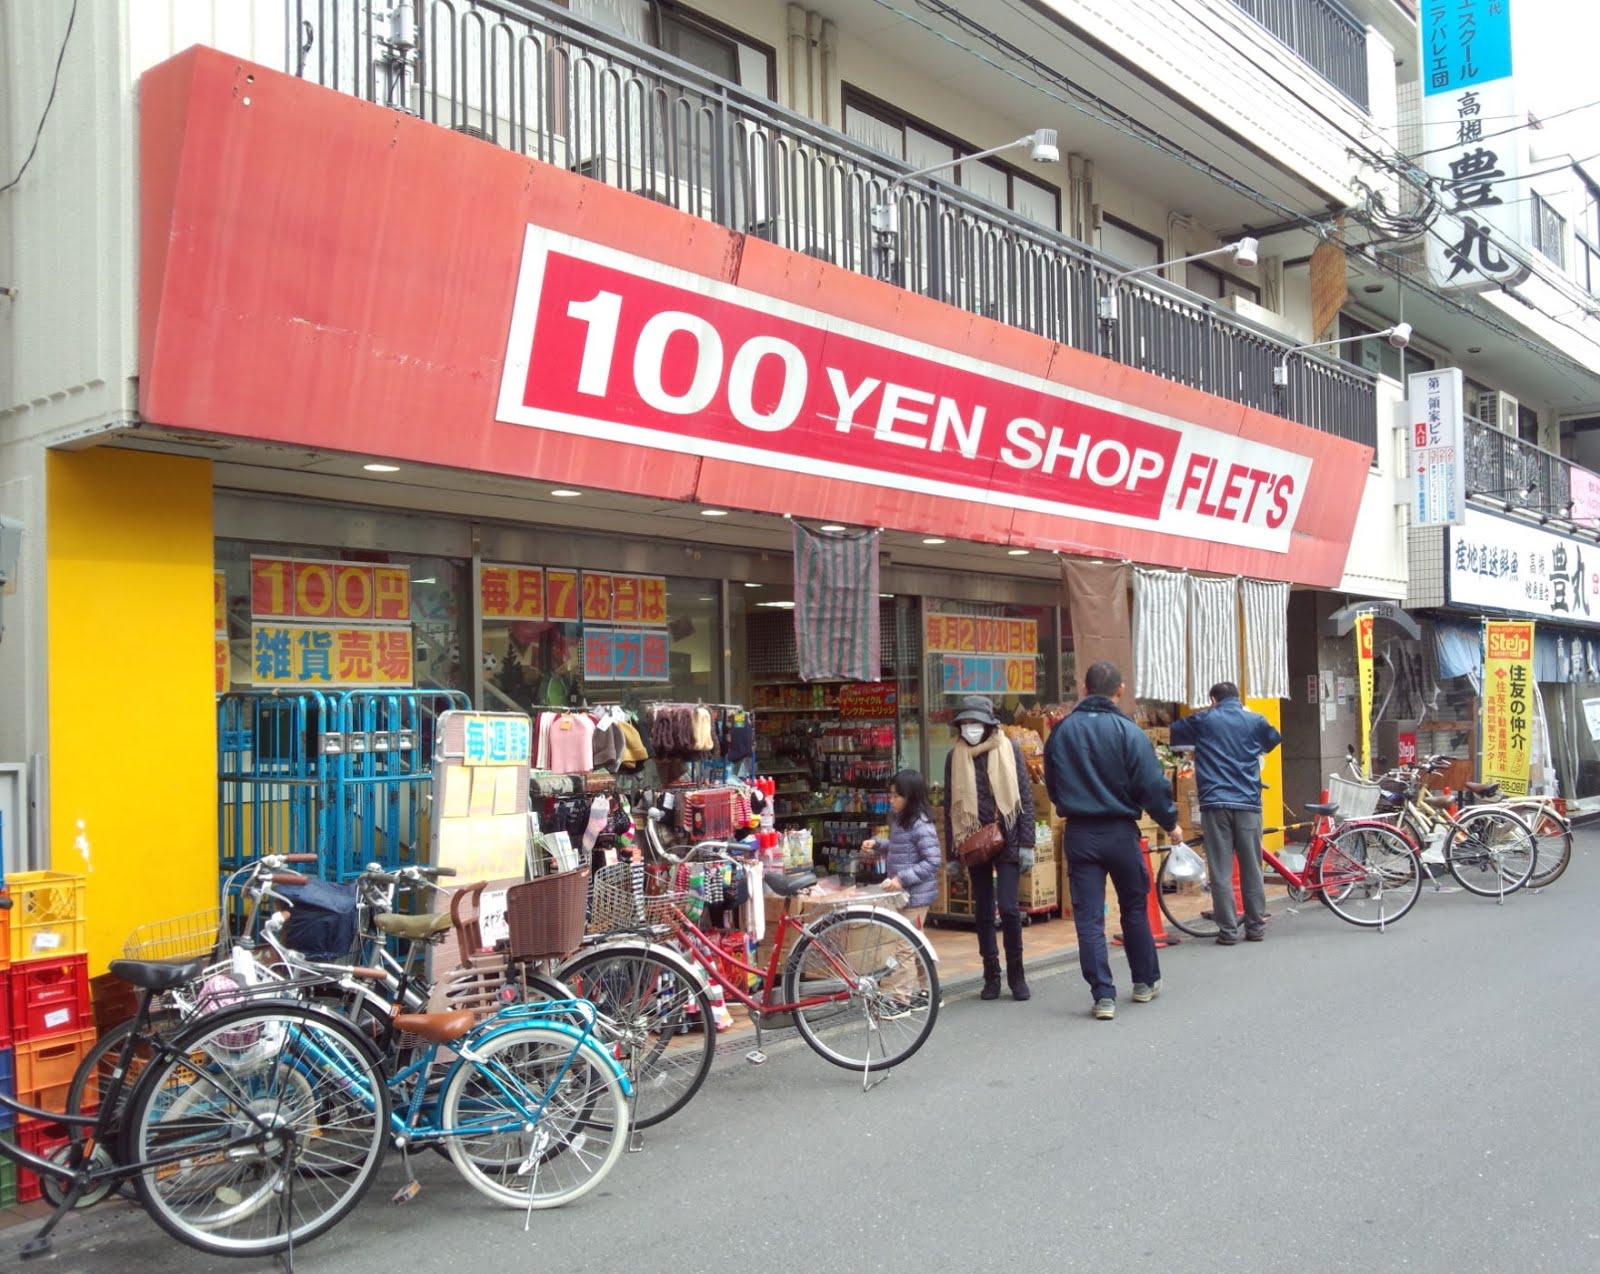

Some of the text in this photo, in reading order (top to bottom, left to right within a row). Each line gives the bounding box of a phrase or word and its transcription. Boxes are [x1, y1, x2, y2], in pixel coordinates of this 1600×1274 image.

[1443, 91, 1509, 281] 高槻 豊丸
[567, 290, 1294, 529] 100 YEN SHOP FLET'S
[1415, 423, 1426, 446] 入口
[257, 561, 409, 619] 100円
[1549, 541, 1590, 617] 豊丸
[255, 628, 411, 681] 雑貨売場
[585, 634, 667, 676] 総力祭
[1490, 631, 1529, 657] Step
[1510, 665, 1526, 750] 住友の仲介
